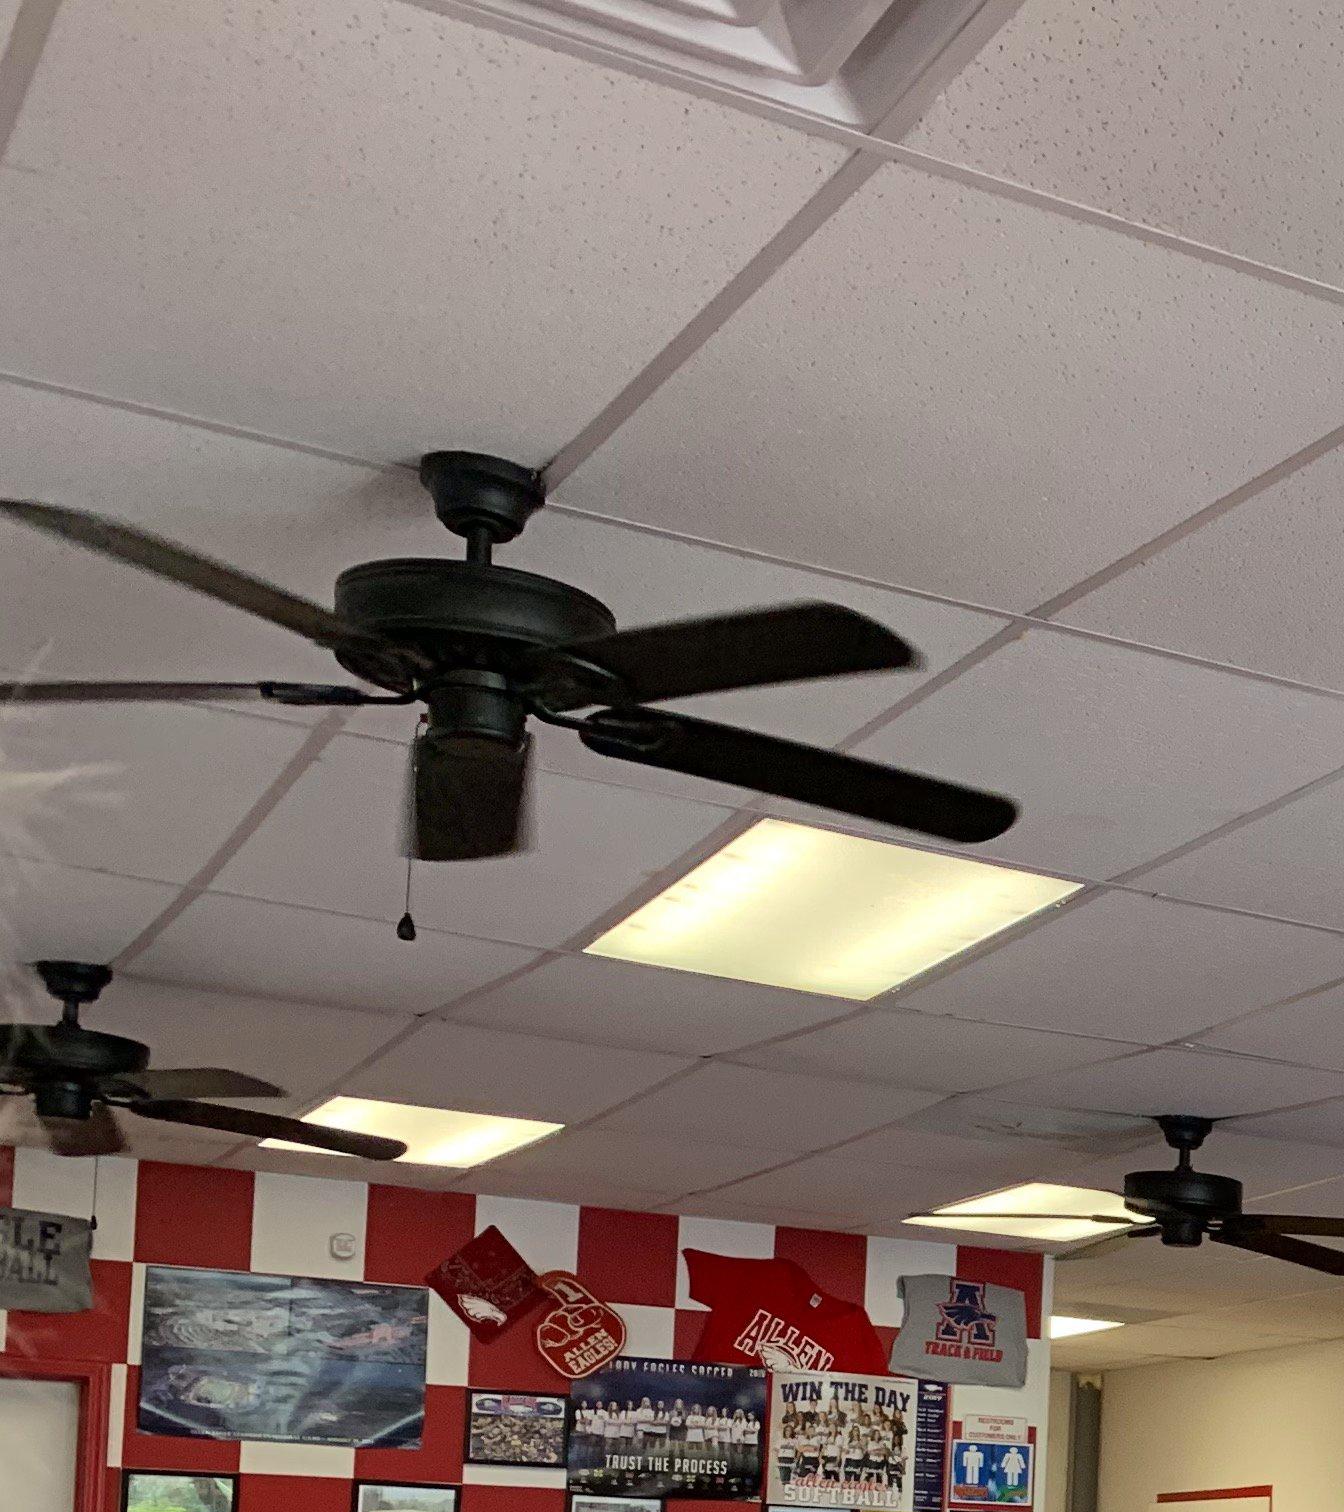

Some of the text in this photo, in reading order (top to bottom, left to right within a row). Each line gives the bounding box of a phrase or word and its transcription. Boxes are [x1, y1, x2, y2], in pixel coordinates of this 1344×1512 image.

[564, 1329, 611, 1363] ALLEN
[569, 1337, 619, 1374] EAGLES!
[734, 1309, 834, 1372] ALLEN
[924, 1340, 962, 1358] TRACK
[972, 1347, 1003, 1363] FIELD
[781, 1381, 911, 1412] WIN THE DAY
[605, 1454, 727, 1475] TRUST THE PROCESS
[783, 1484, 899, 1508] SOFTBALL
